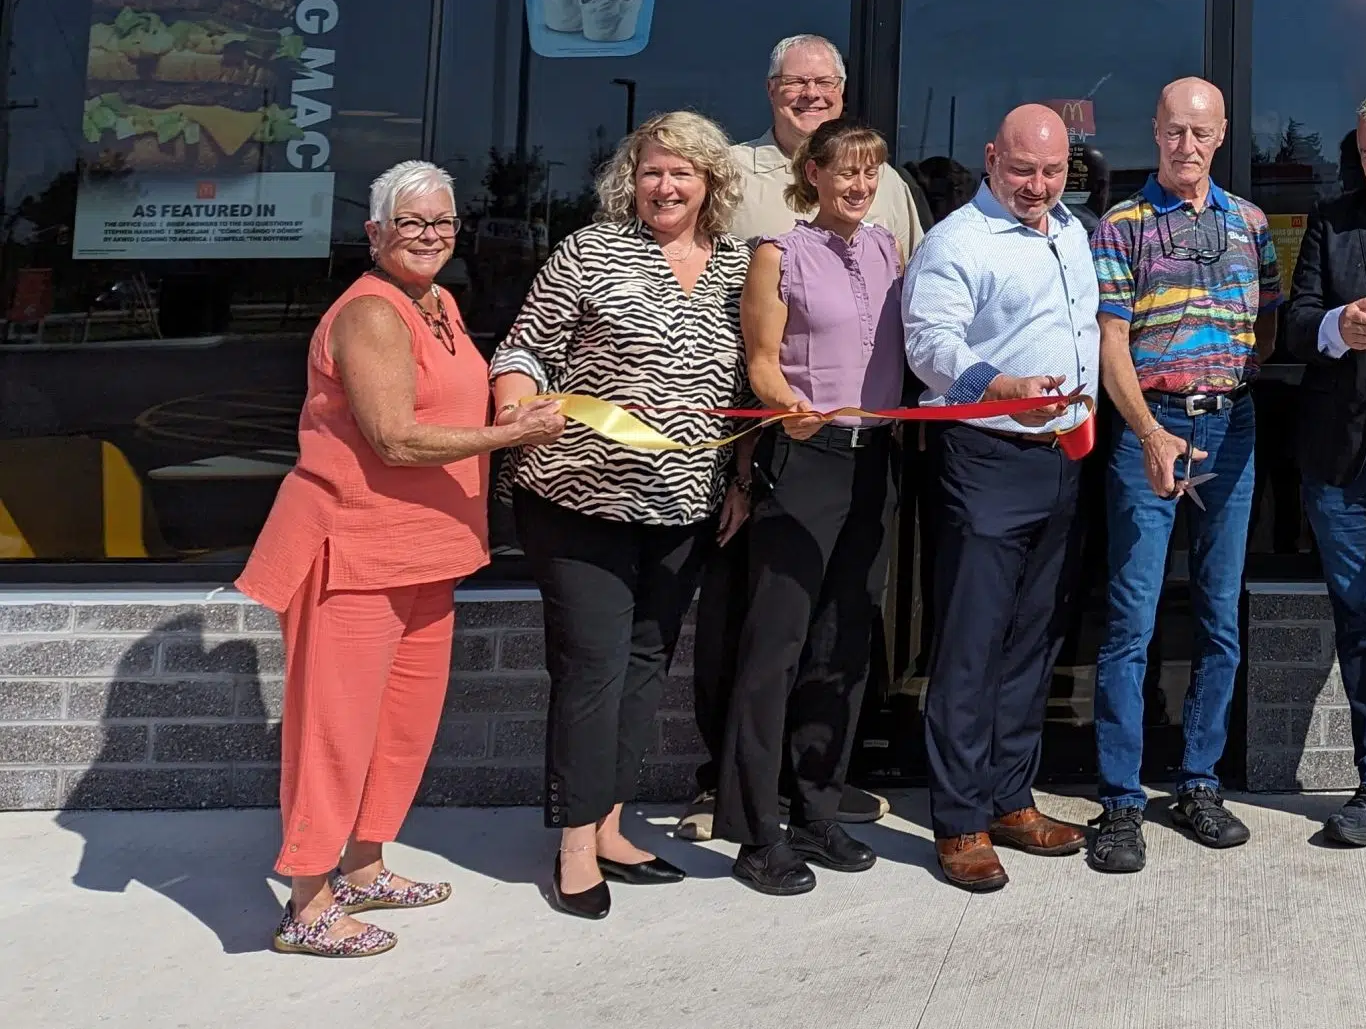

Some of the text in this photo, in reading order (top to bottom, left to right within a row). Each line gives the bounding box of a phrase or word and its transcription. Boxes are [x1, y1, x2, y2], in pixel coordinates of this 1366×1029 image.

[286, 46, 336, 170] MAC
[132, 204, 276, 218] AS FEATURED IN
